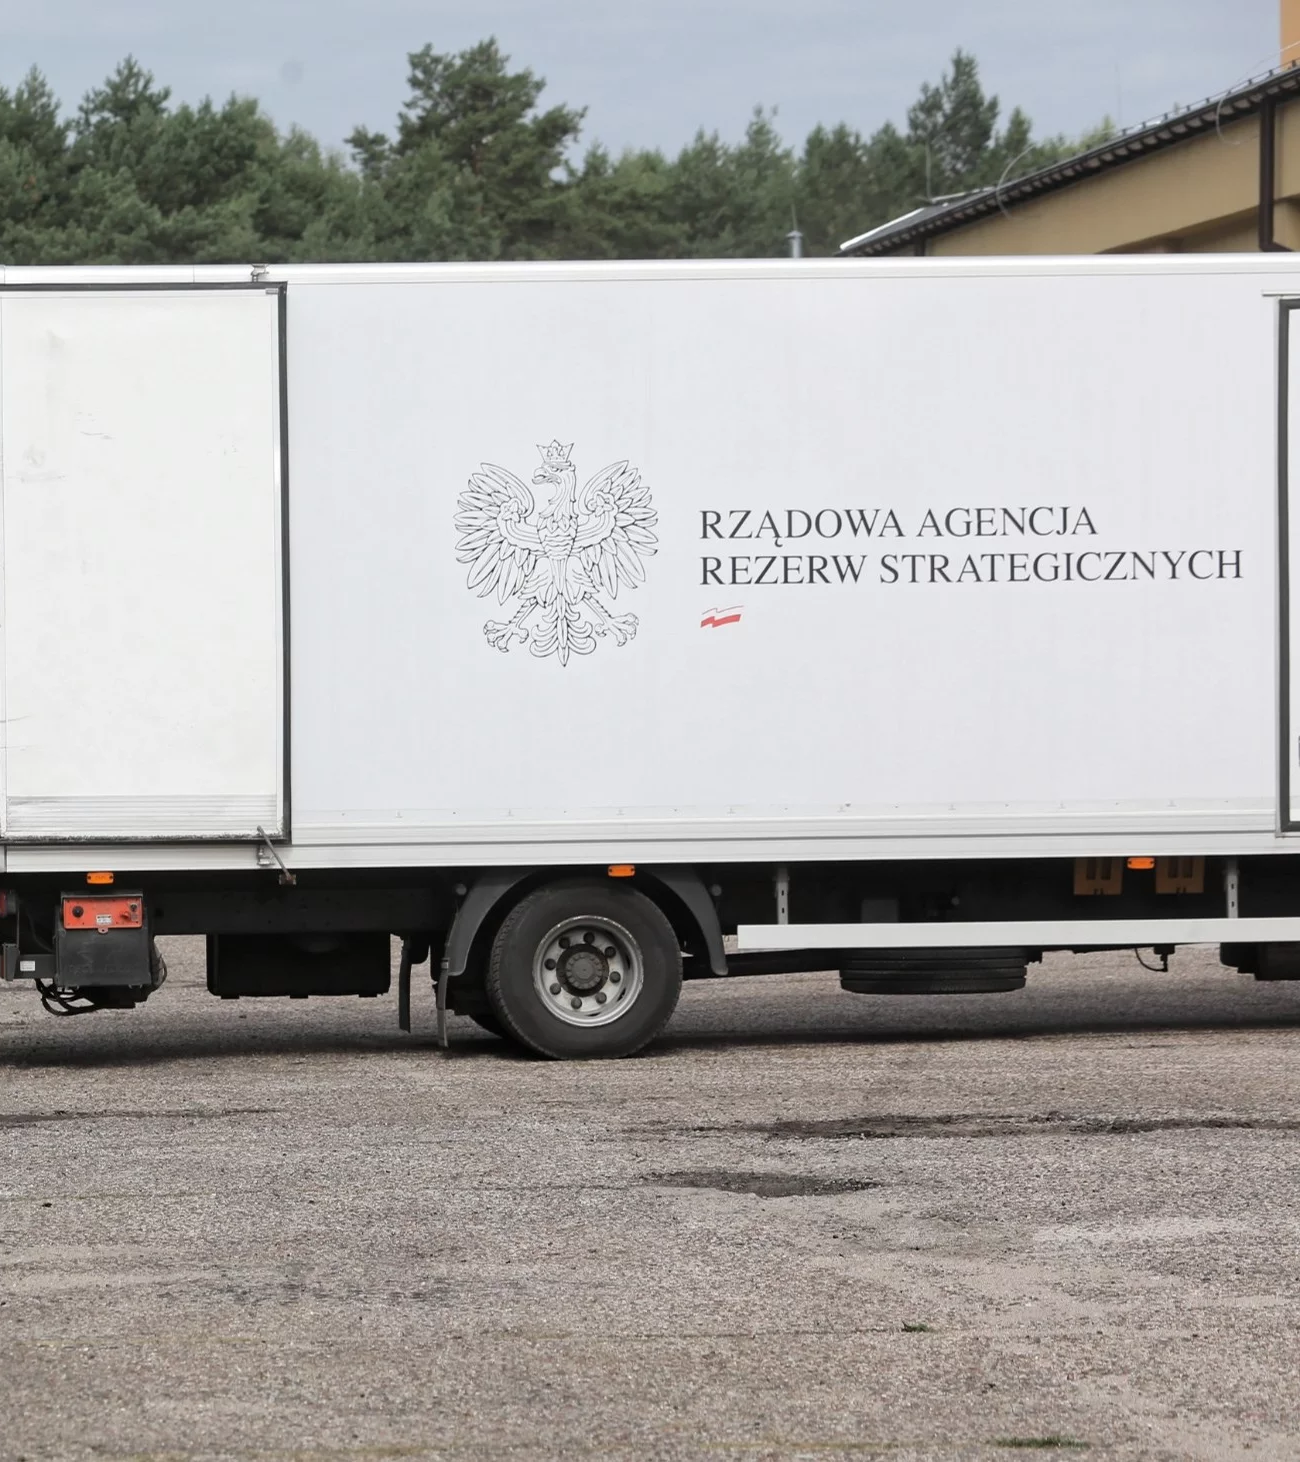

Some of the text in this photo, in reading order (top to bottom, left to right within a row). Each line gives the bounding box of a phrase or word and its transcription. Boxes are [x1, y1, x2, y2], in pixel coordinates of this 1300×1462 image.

[699, 506, 1099, 547] RZĄDOWA AGENCJA
[699, 550, 1243, 585] REZERW STRATEGICZNYCH
